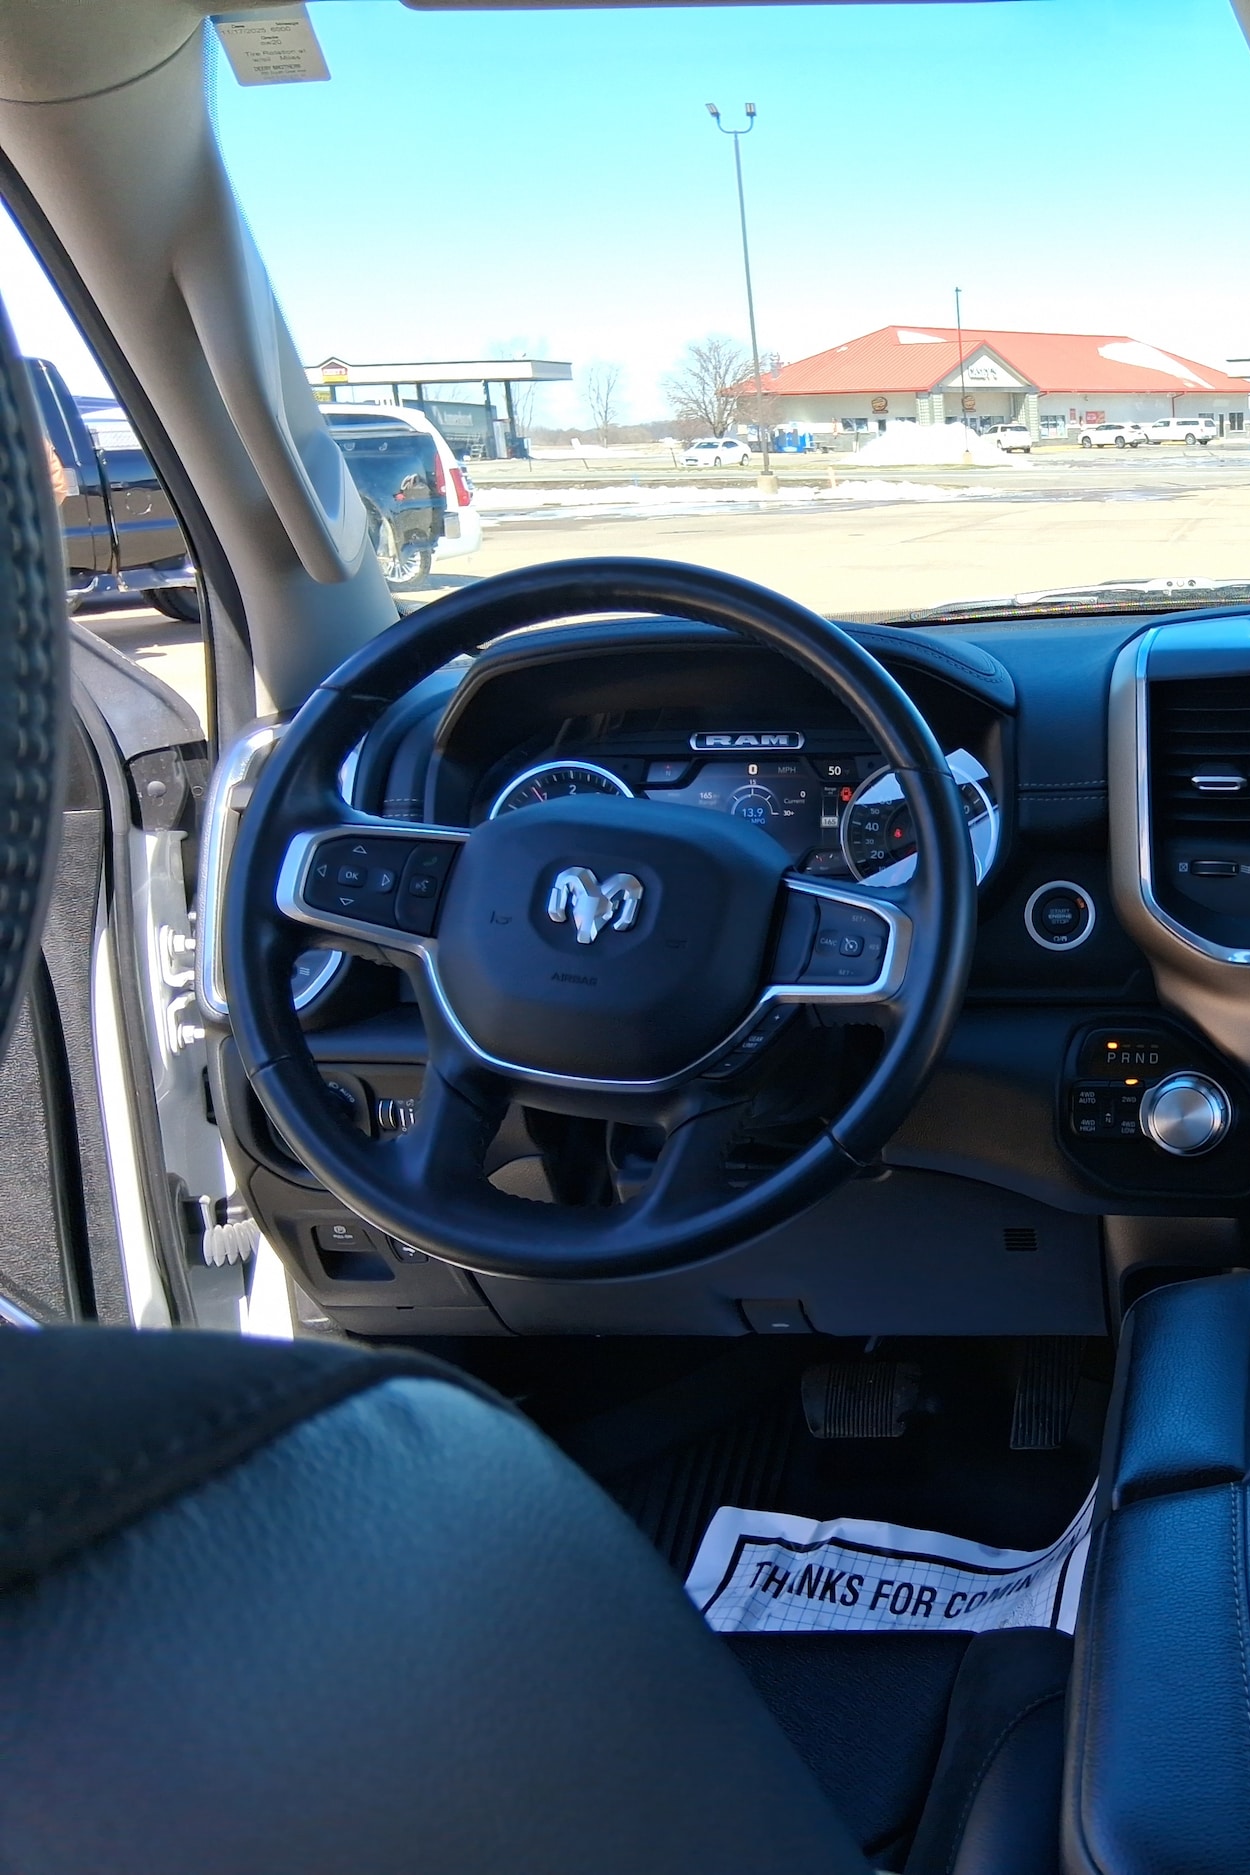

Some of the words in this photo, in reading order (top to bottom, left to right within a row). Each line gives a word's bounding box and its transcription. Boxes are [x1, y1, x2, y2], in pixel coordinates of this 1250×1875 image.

[704, 735, 791, 746] RAM
[748, 764, 758, 775] 0
[777, 766, 797, 774] MPH
[827, 766, 842, 776] 50
[568, 785, 577, 796] 2
[799, 791, 806, 799] 0
[700, 792, 713, 800] 165
[741, 808, 764, 819] 13.9
[824, 819, 837, 827] 165
[865, 822, 879, 832] 40
[870, 850, 885, 860] 20
[345, 871, 359, 881] OK
[551, 971, 599, 987] AIRBAG
[1107, 1051, 1117, 1064] P
[1121, 1051, 1131, 1064] R
[1135, 1051, 1145, 1064] N
[1149, 1052, 1159, 1065] D
[340, 1087, 356, 1104] AUTO
[1078, 1097, 1097, 1105] AUTO
[1120, 1120, 1136, 1128] 4WD
[869, 1579, 937, 1618] FOR
